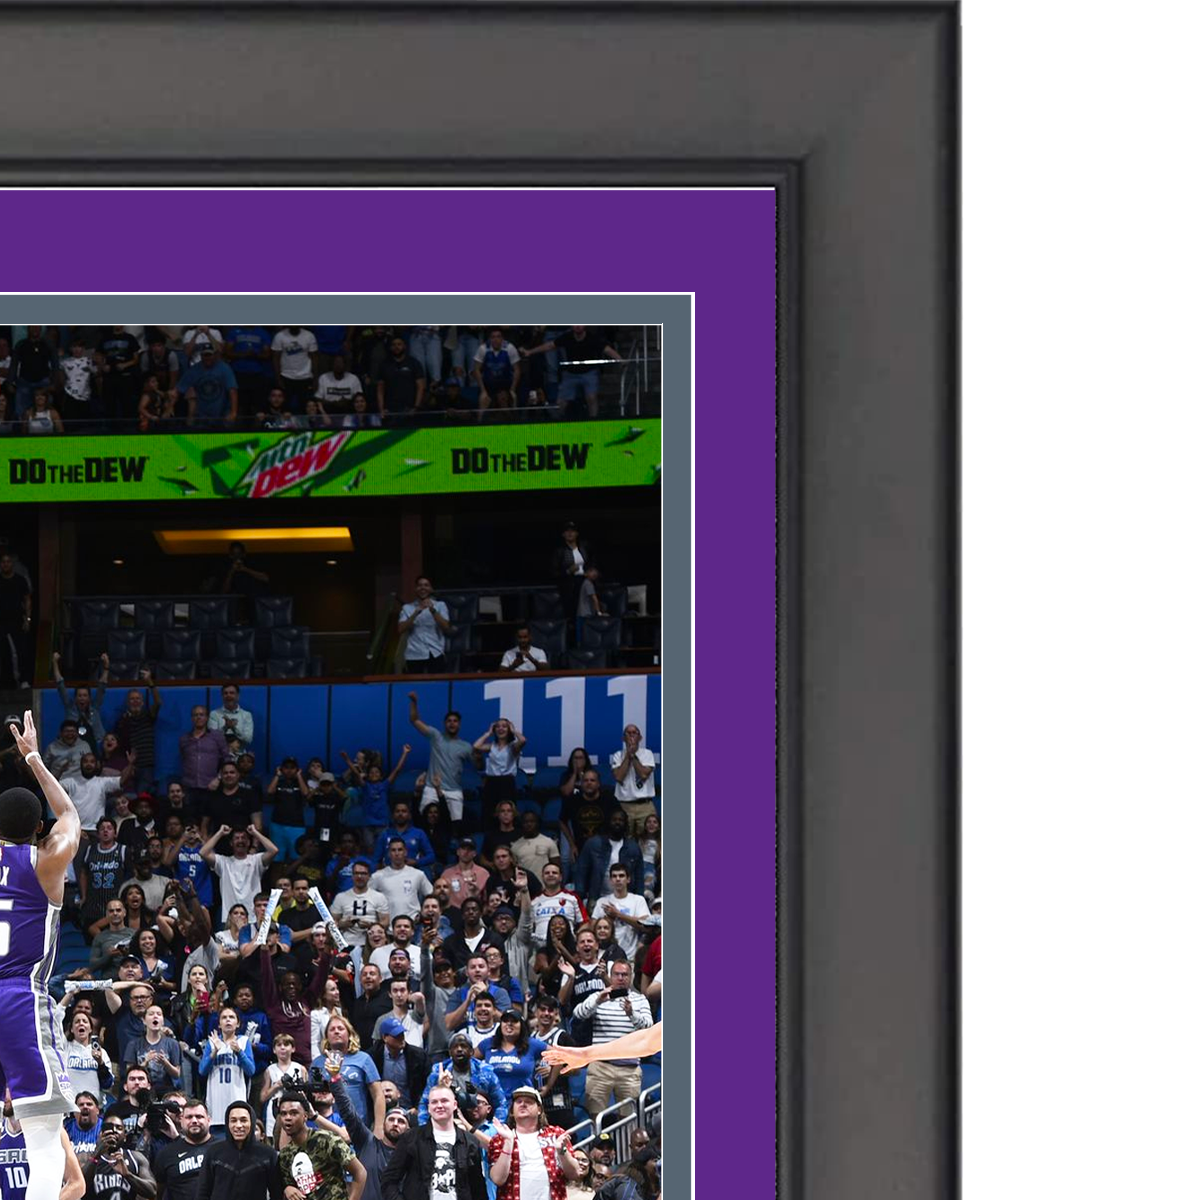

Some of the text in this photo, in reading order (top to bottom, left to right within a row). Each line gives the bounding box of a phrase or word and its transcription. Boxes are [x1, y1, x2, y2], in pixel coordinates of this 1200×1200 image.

[484, 675, 660, 768] 111
[189, 864, 197, 877] 5
[93, 872, 115, 889] 32
[219, 1068, 232, 1084] 10
